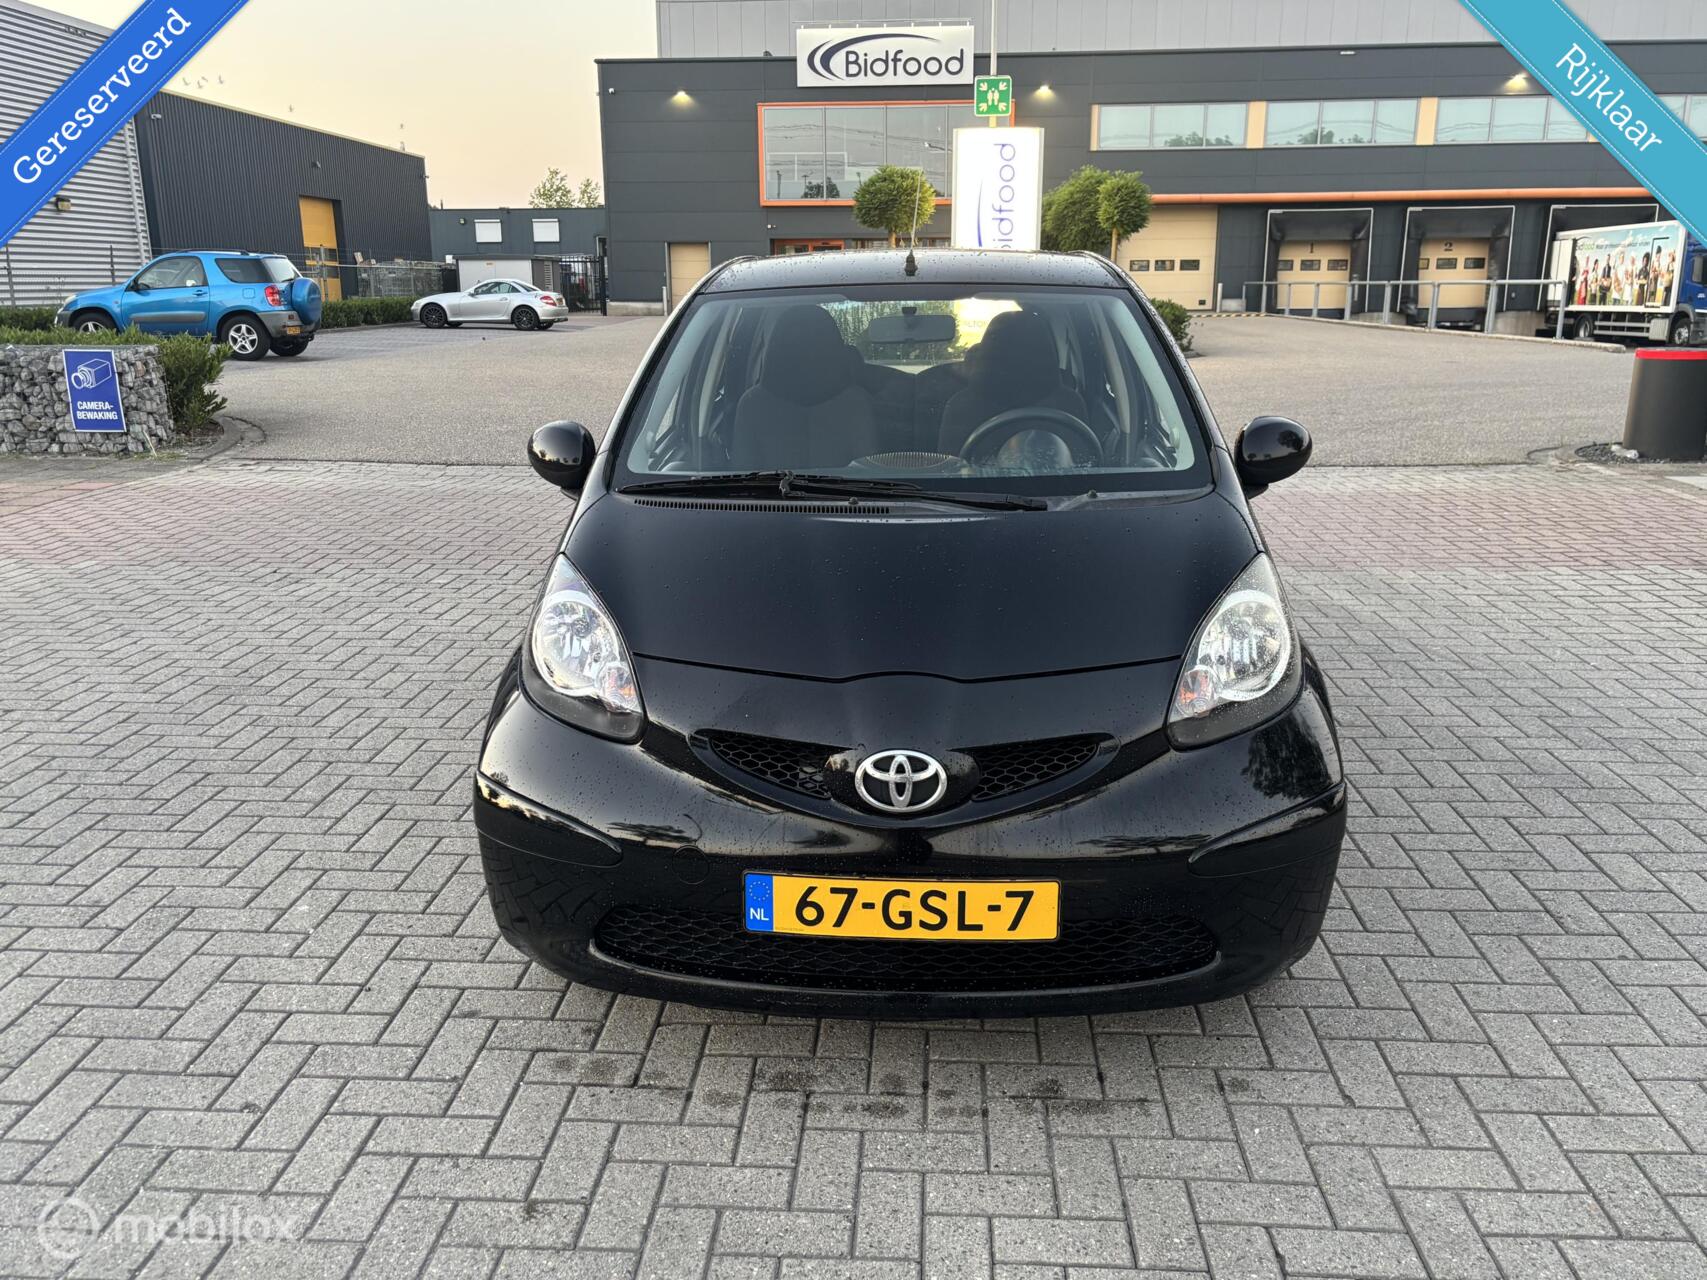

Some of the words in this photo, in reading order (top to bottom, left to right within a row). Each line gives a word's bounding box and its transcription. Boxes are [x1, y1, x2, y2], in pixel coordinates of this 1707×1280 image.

[845, 48, 964, 78] Bidfood
[1309, 242, 1314, 254] 1
[1444, 241, 1454, 252] 2
[77, 401, 114, 410] CAMERA-
[77, 411, 118, 420] BEWAKING
[749, 907, 769, 921] NL
[795, 886, 1034, 932] 67-GSL-7
